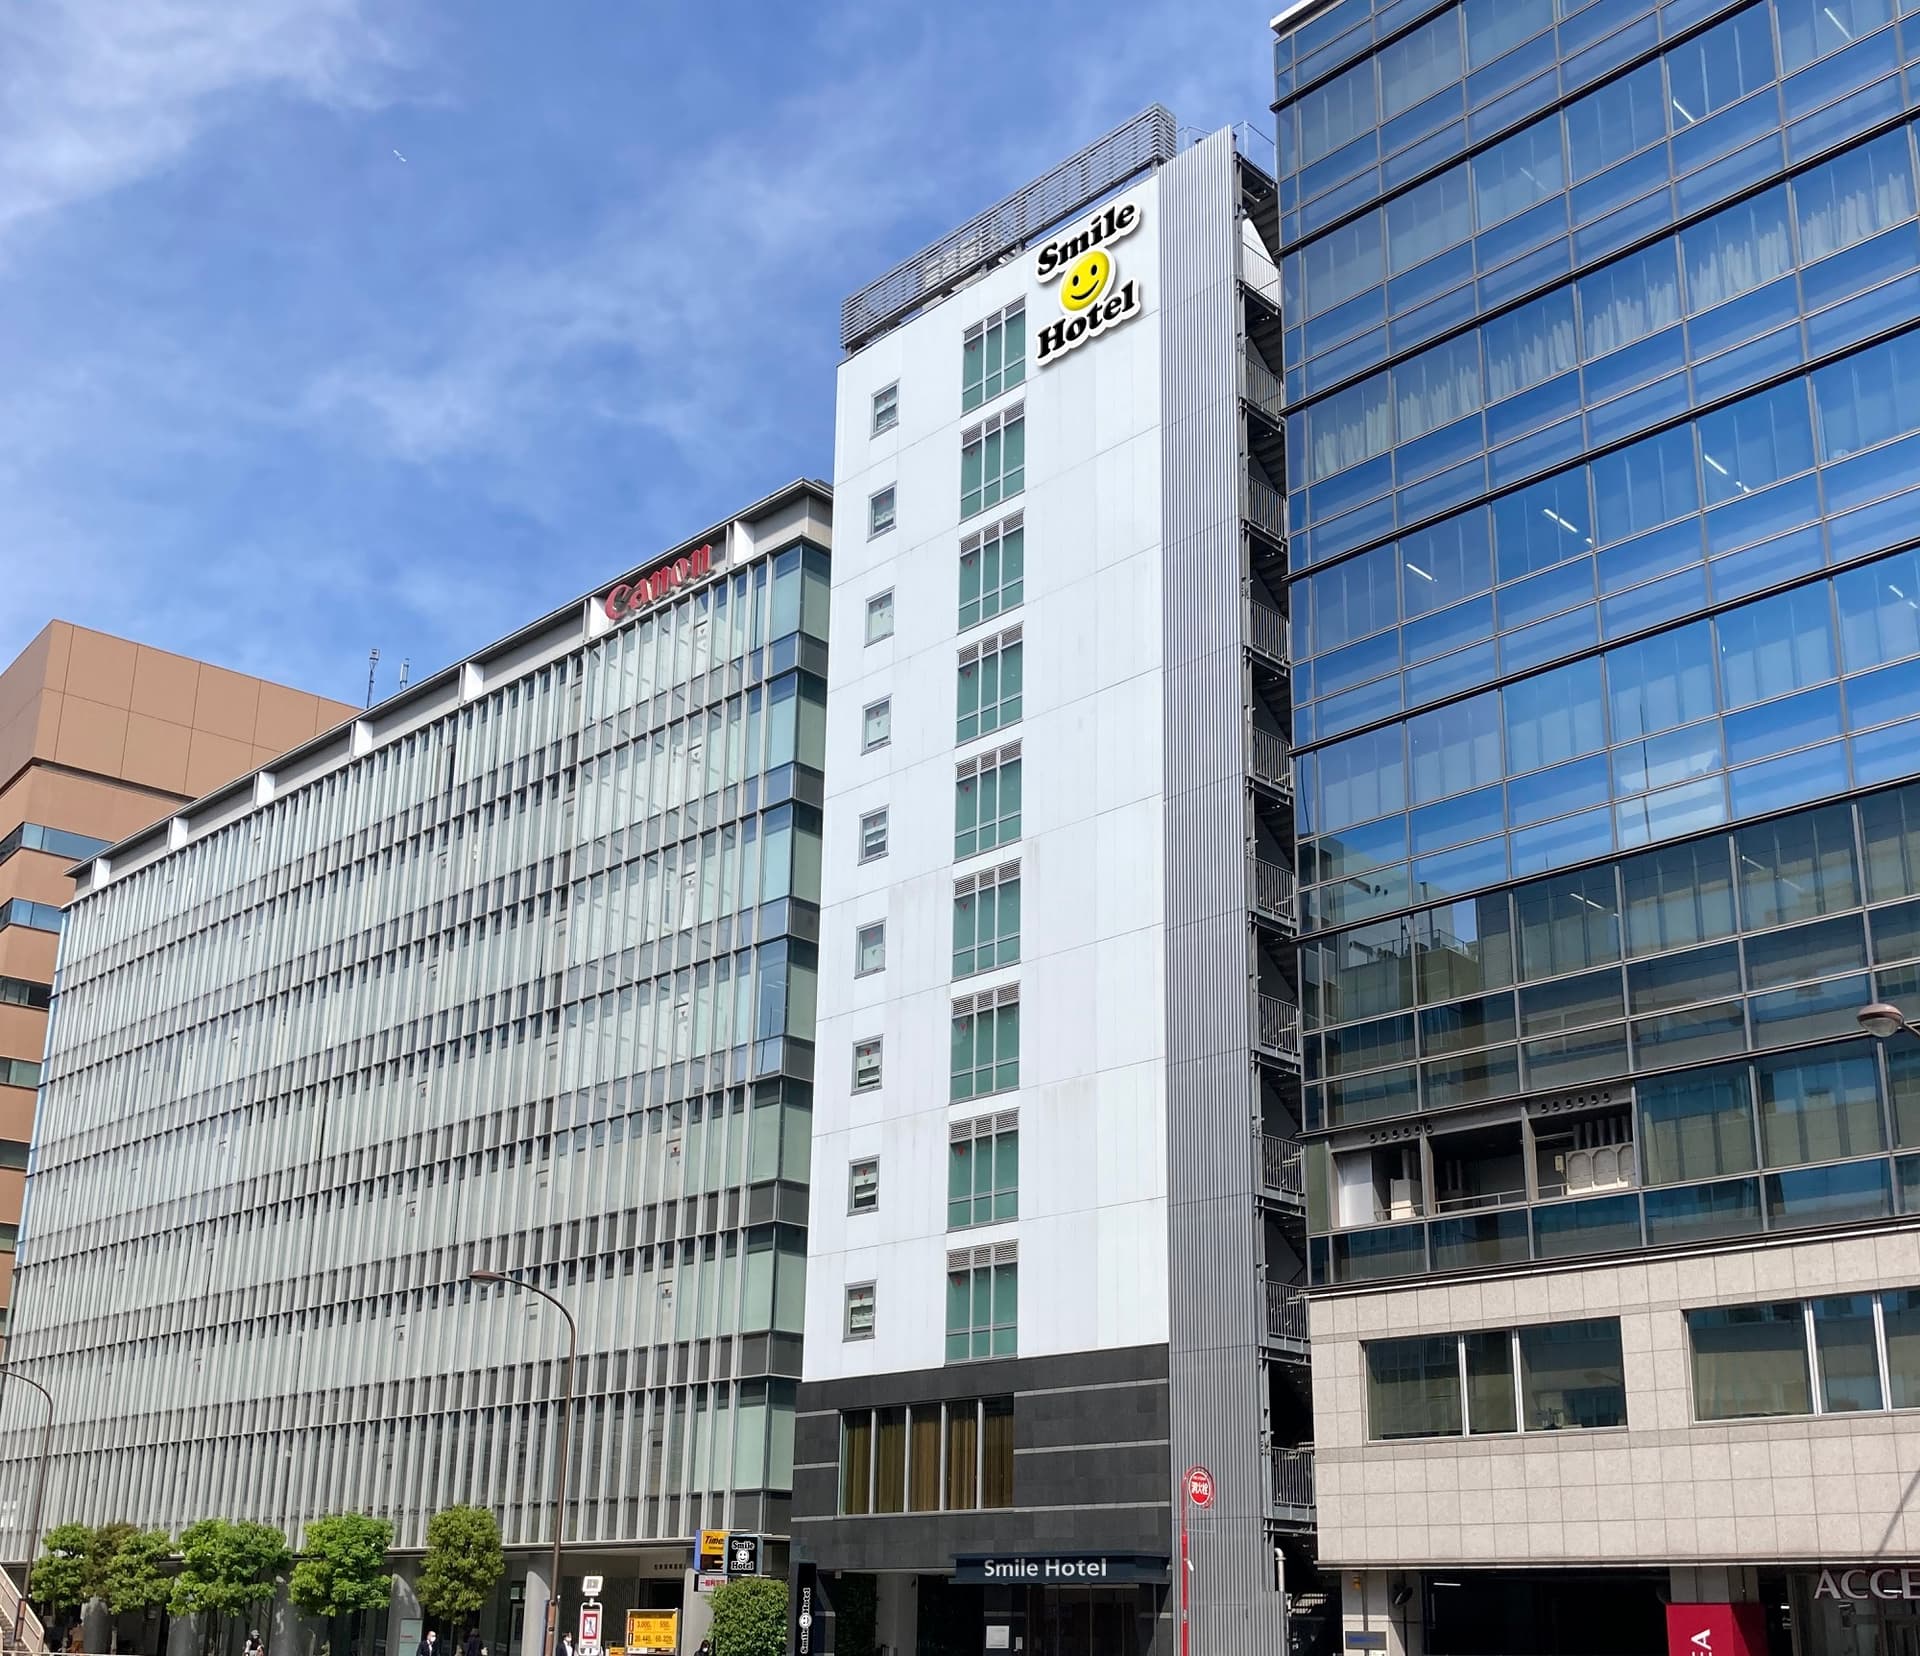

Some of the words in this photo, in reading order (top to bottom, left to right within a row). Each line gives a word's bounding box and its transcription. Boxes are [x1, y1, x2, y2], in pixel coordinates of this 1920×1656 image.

[1037, 204, 1135, 276] Smile
[1037, 280, 1135, 359] Hotel
[604, 543, 713, 621] Canon
[705, 1535, 725, 1545] Time
[732, 1540, 755, 1550] Smile
[731, 1561, 754, 1570] Hotel
[984, 1559, 1039, 1577] Smile
[1045, 1557, 1107, 1577] Hotel
[802, 1588, 811, 1615] Hotel
